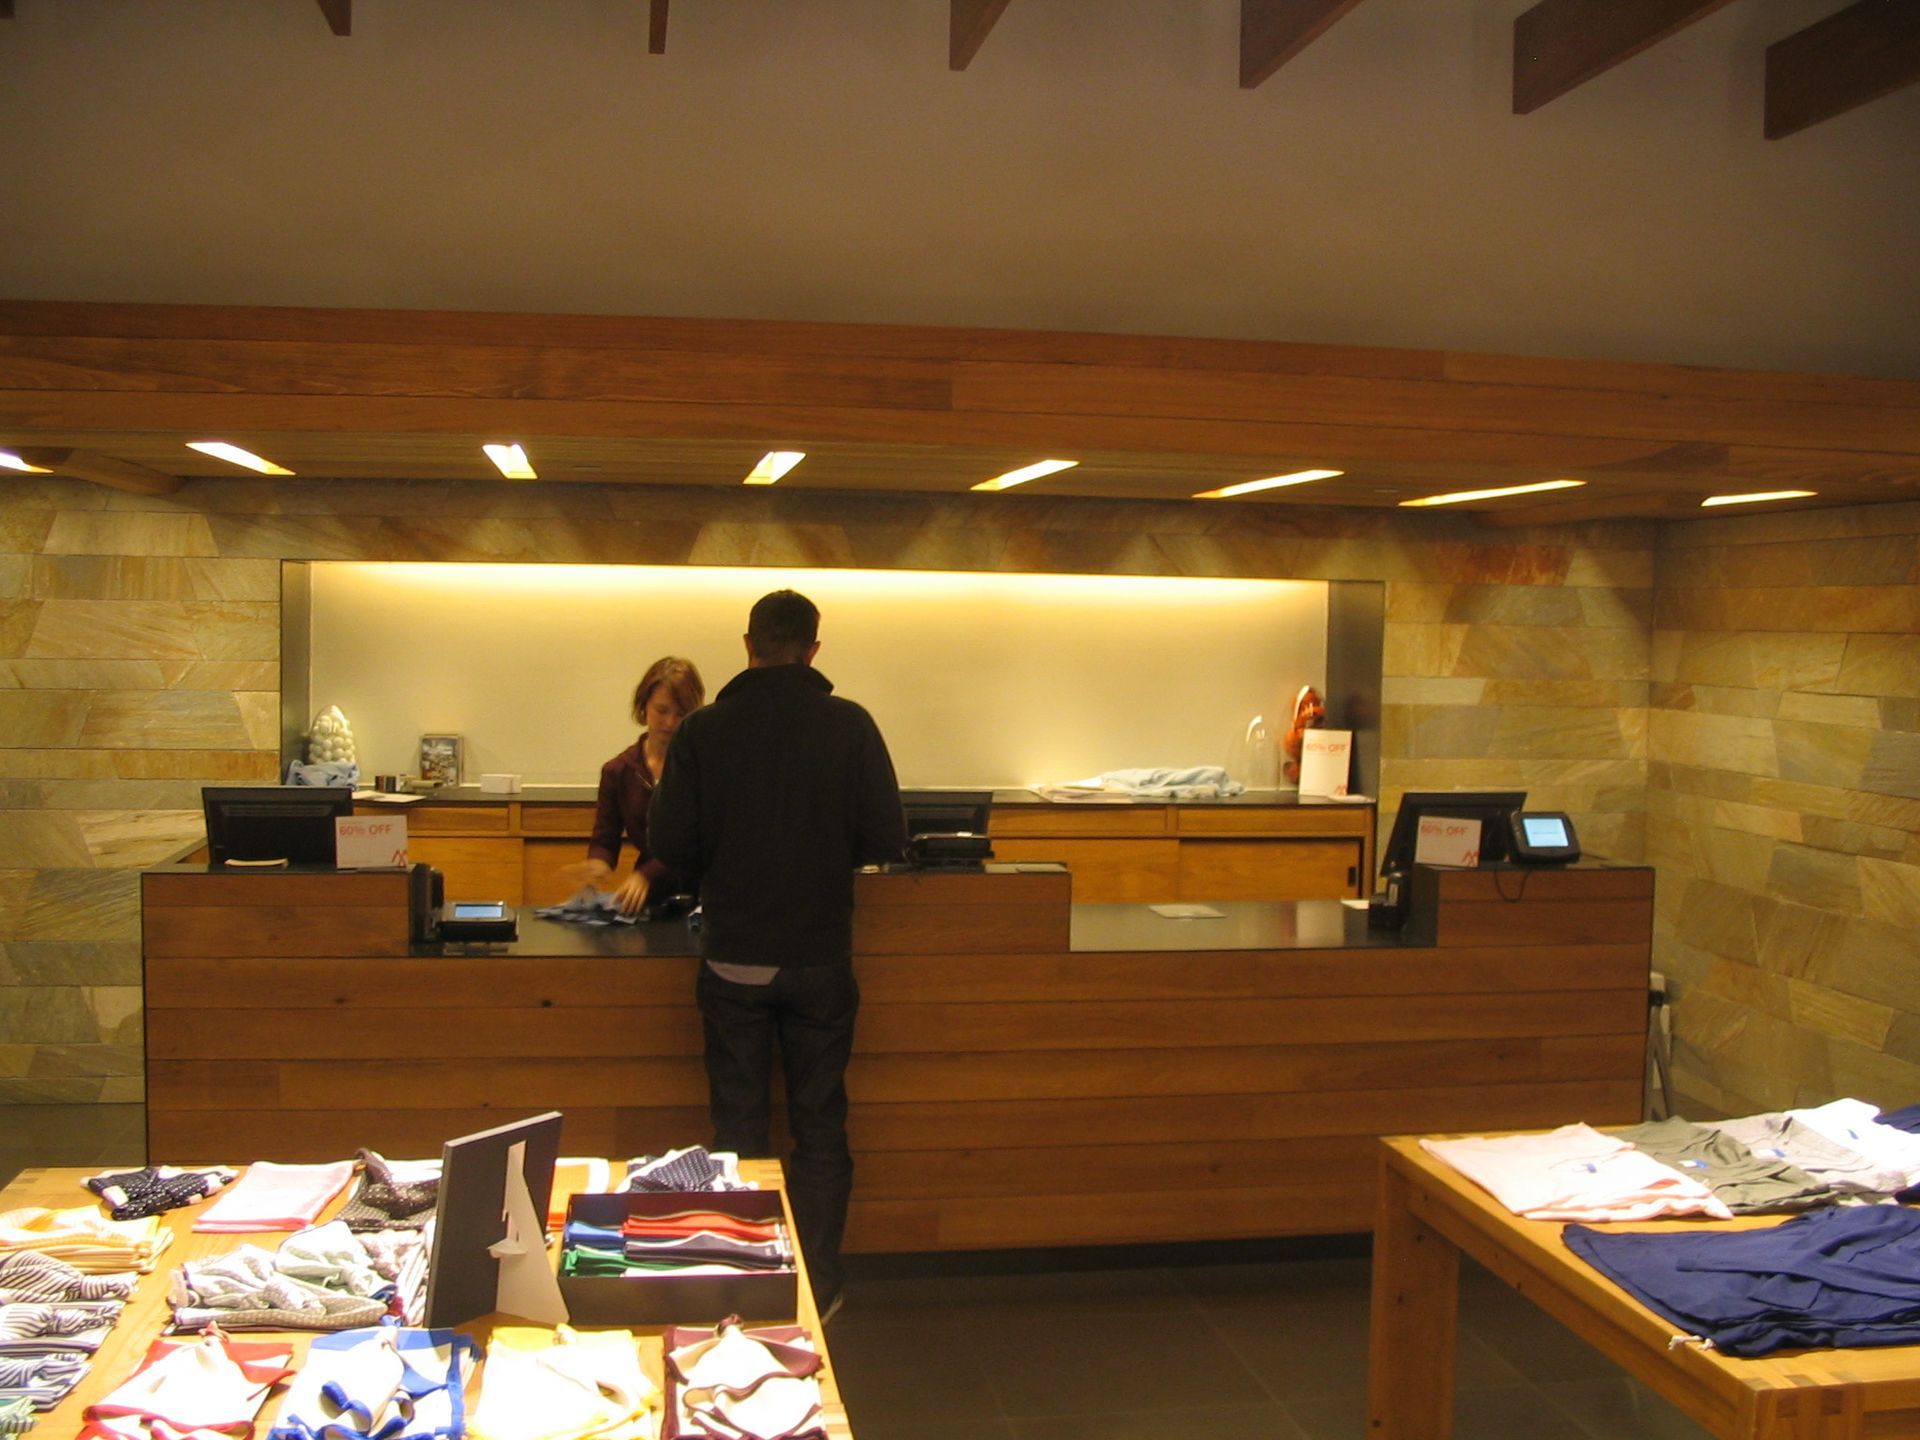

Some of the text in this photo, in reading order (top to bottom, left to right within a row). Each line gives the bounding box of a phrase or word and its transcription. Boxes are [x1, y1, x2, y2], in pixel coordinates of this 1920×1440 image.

[1328, 743, 1348, 753] OFF
[368, 824, 393, 835] OFF
[1446, 825, 1468, 836] OFF
